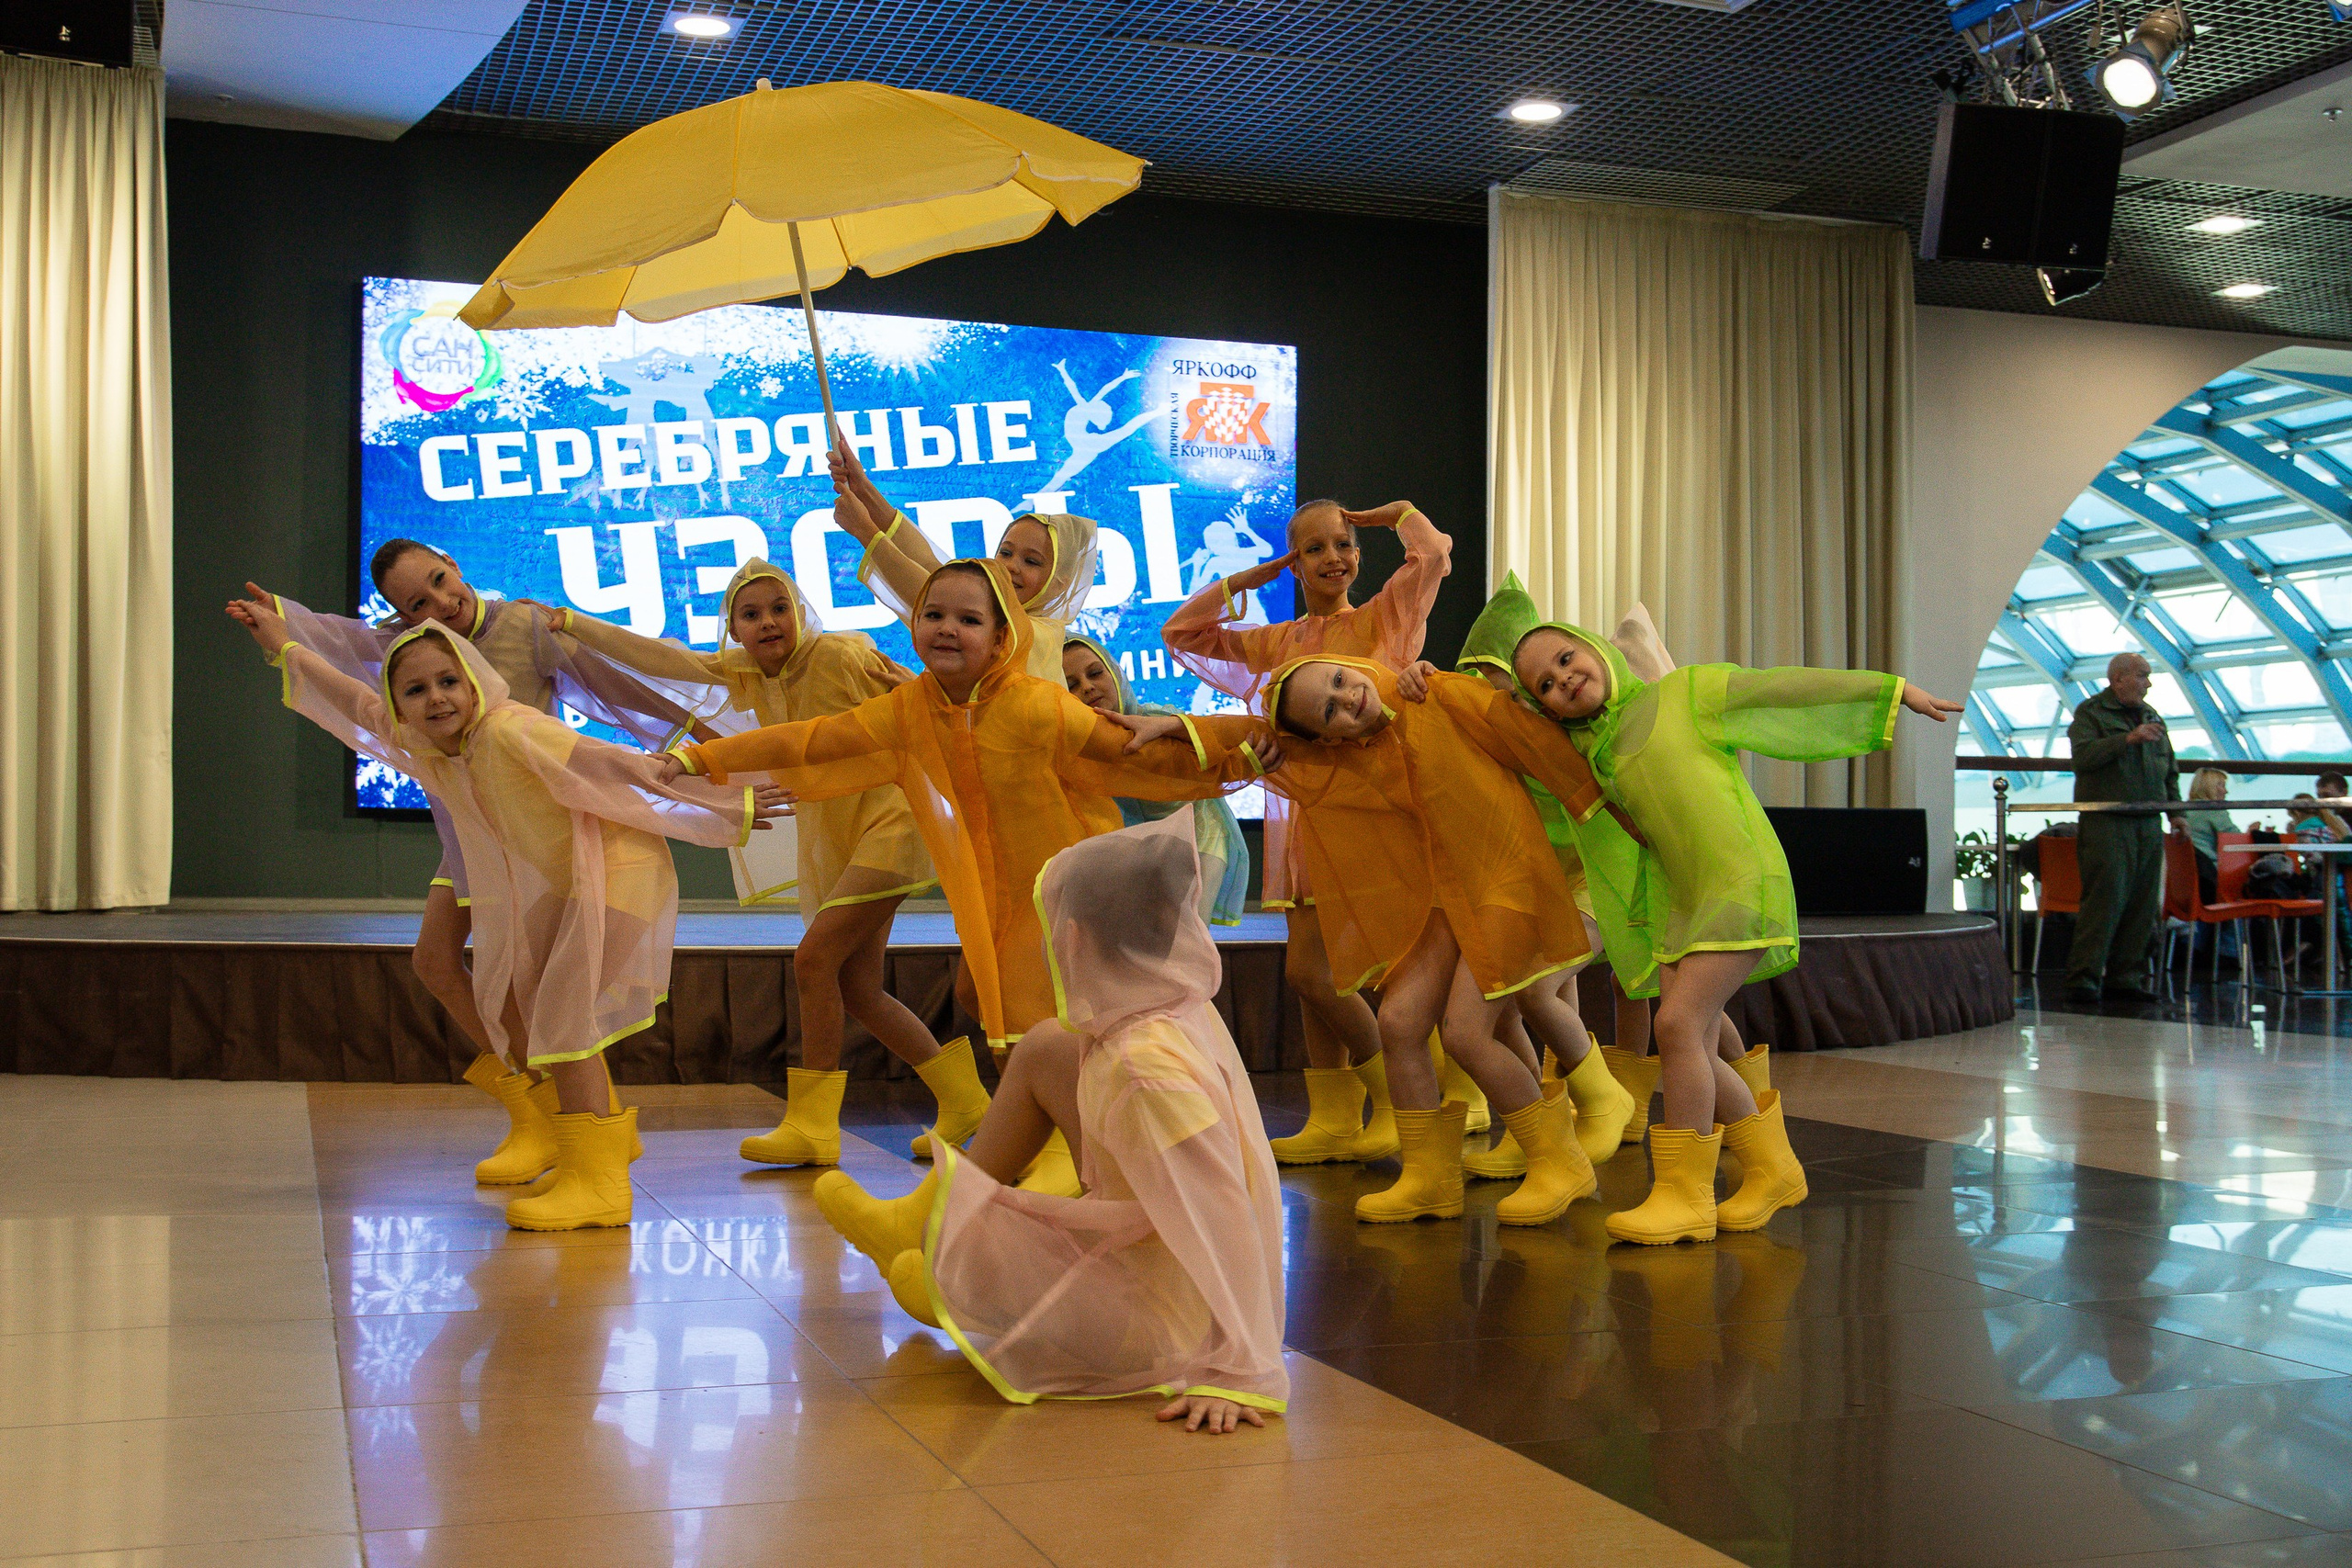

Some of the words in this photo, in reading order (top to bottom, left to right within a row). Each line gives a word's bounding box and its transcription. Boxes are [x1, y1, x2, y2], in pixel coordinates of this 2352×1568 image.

[413, 335, 473, 359] САН
[412, 355, 472, 376] СИТИ
[1172, 359, 1257, 379] ЯРКОФФ
[1170, 392, 1179, 458] ТВОРЧЕСКАЯ
[419, 400, 1037, 502] СЕРЕБРЯНЫЕ
[1181, 445, 1276, 462] КОРПОРАЦИЯ
